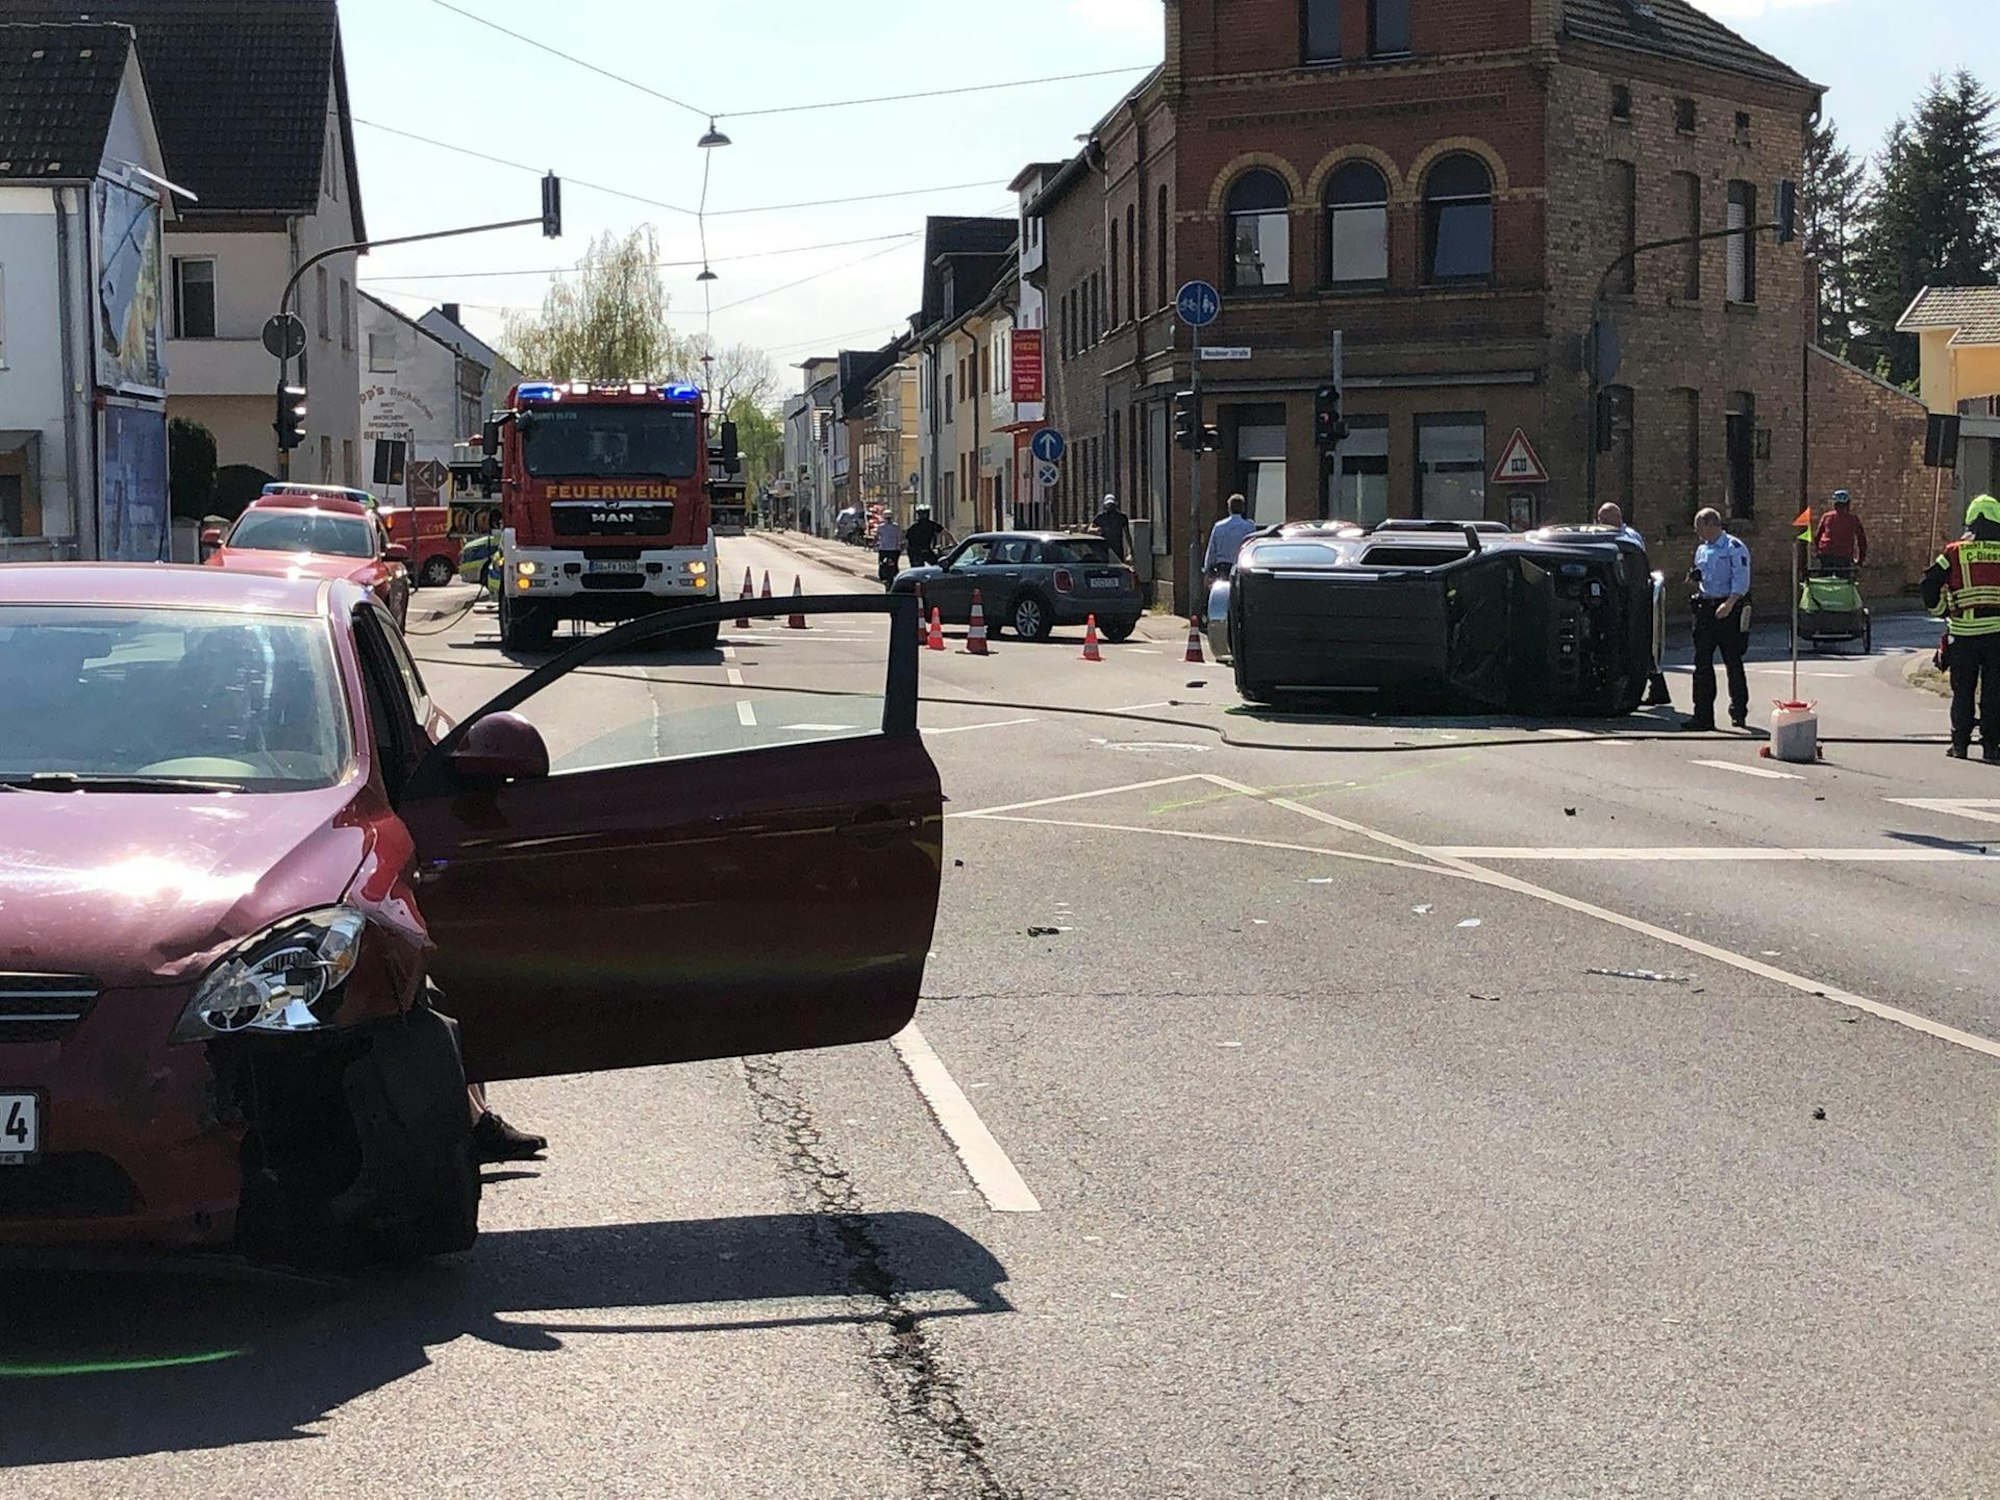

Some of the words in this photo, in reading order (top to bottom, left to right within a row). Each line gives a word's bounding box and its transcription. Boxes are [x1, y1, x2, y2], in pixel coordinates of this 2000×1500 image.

[363, 431, 385, 440] SEIT
[545, 485, 678, 499] FEUERWEHR
[591, 513, 634, 523] MAN
[0, 1101, 28, 1144] 4
